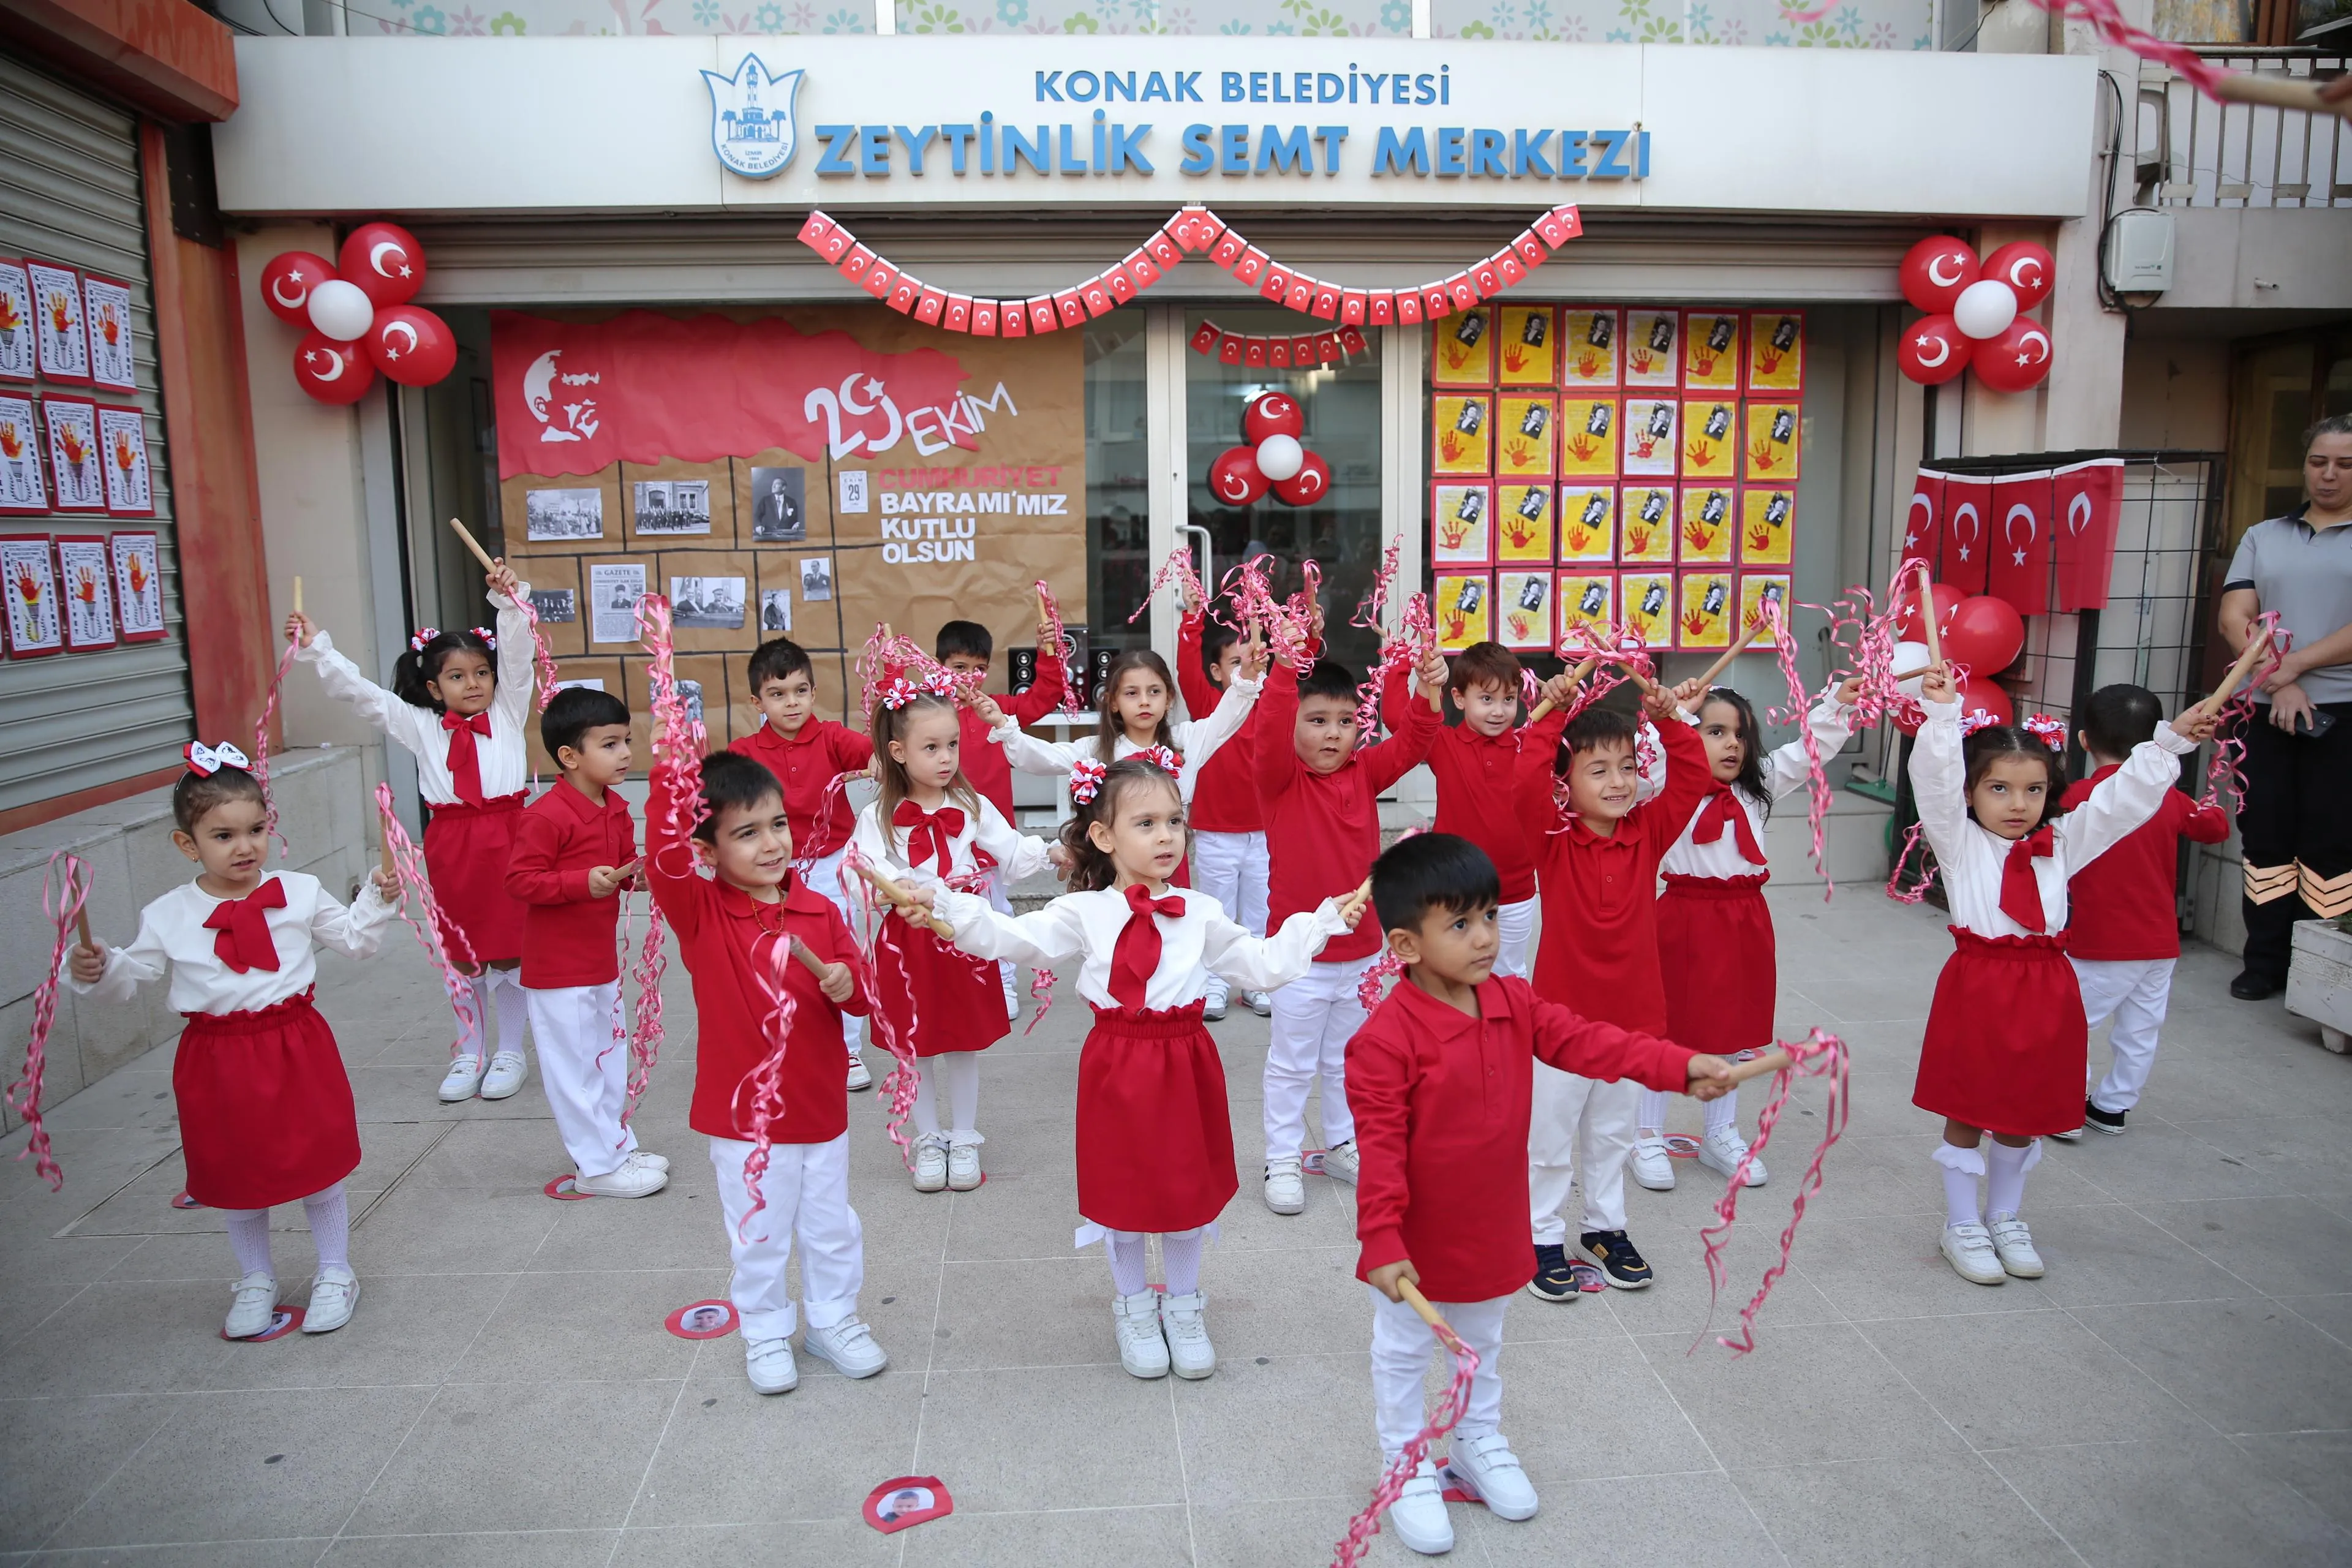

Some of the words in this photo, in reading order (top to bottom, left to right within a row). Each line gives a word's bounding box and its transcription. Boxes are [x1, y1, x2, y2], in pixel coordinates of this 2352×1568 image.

[1035, 70, 1202, 102] KONAK
[1221, 62, 1450, 106] BELEDİYESİ
[721, 143, 745, 168] KONAK
[747, 141, 789, 169] BELEDİYESİ
[814, 108, 1155, 176] ZEYTİNLİK
[1179, 124, 1349, 177] SEMT
[804, 372, 903, 461] 29
[905, 381, 1018, 457] EKİM
[878, 462, 1063, 490] CUMHURİYET
[848, 484, 860, 501] 29
[880, 518, 976, 540] KUTLU
[882, 540, 976, 564] OLSUN
